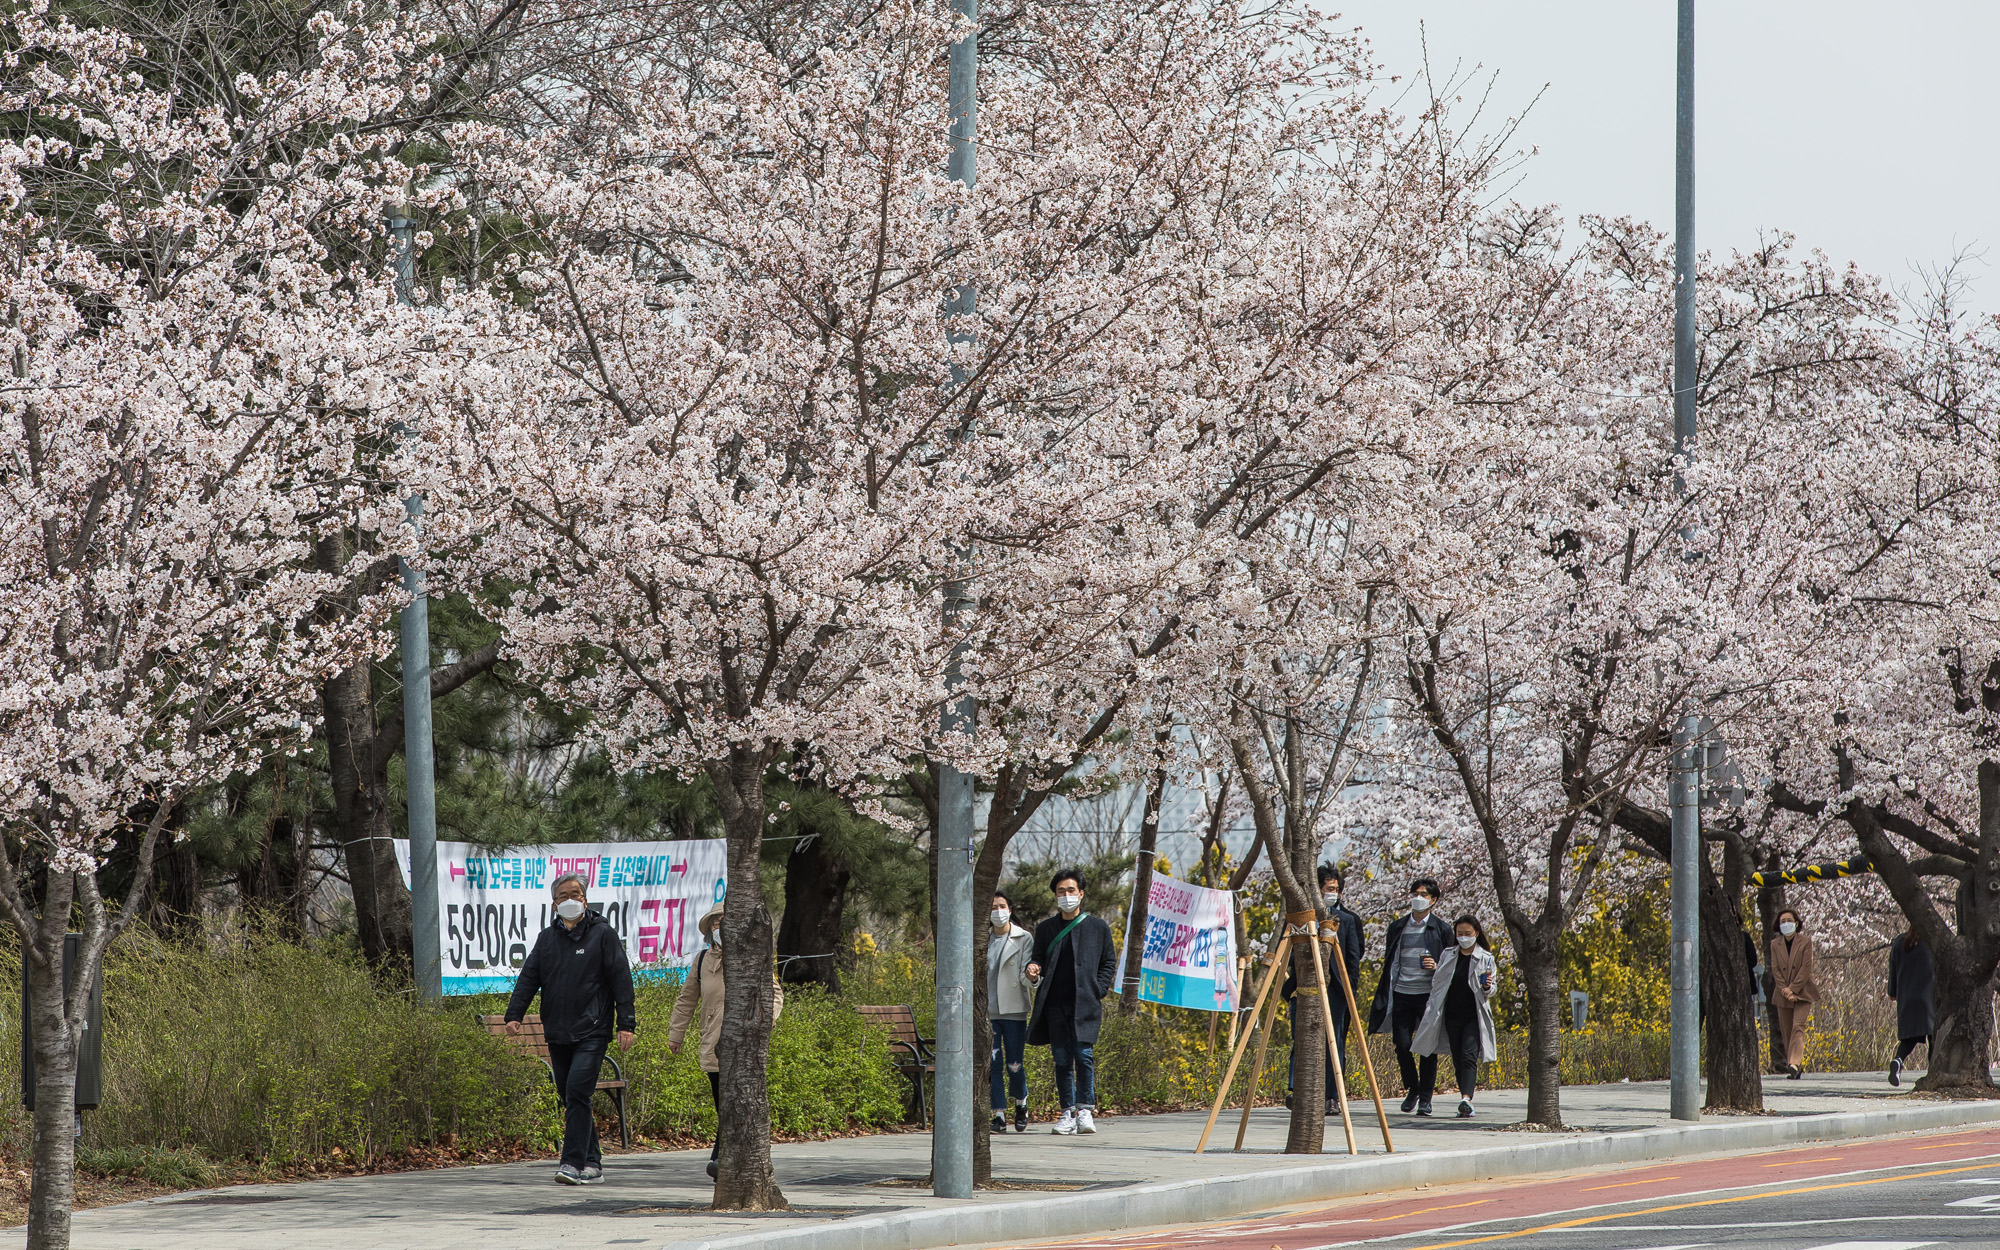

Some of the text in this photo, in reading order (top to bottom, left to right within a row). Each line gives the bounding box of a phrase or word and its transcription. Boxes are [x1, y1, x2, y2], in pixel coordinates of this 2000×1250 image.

[466, 857, 487, 889] 우리
[488, 857, 522, 889] 모두를
[524, 857, 546, 889] 위한
[612, 855, 670, 887] 실천합시다
[447, 903, 527, 969] 5인이상
[639, 898, 686, 962] 금지
[1165, 923, 1198, 968] 온라인
[1189, 928, 1214, 969] 개최
